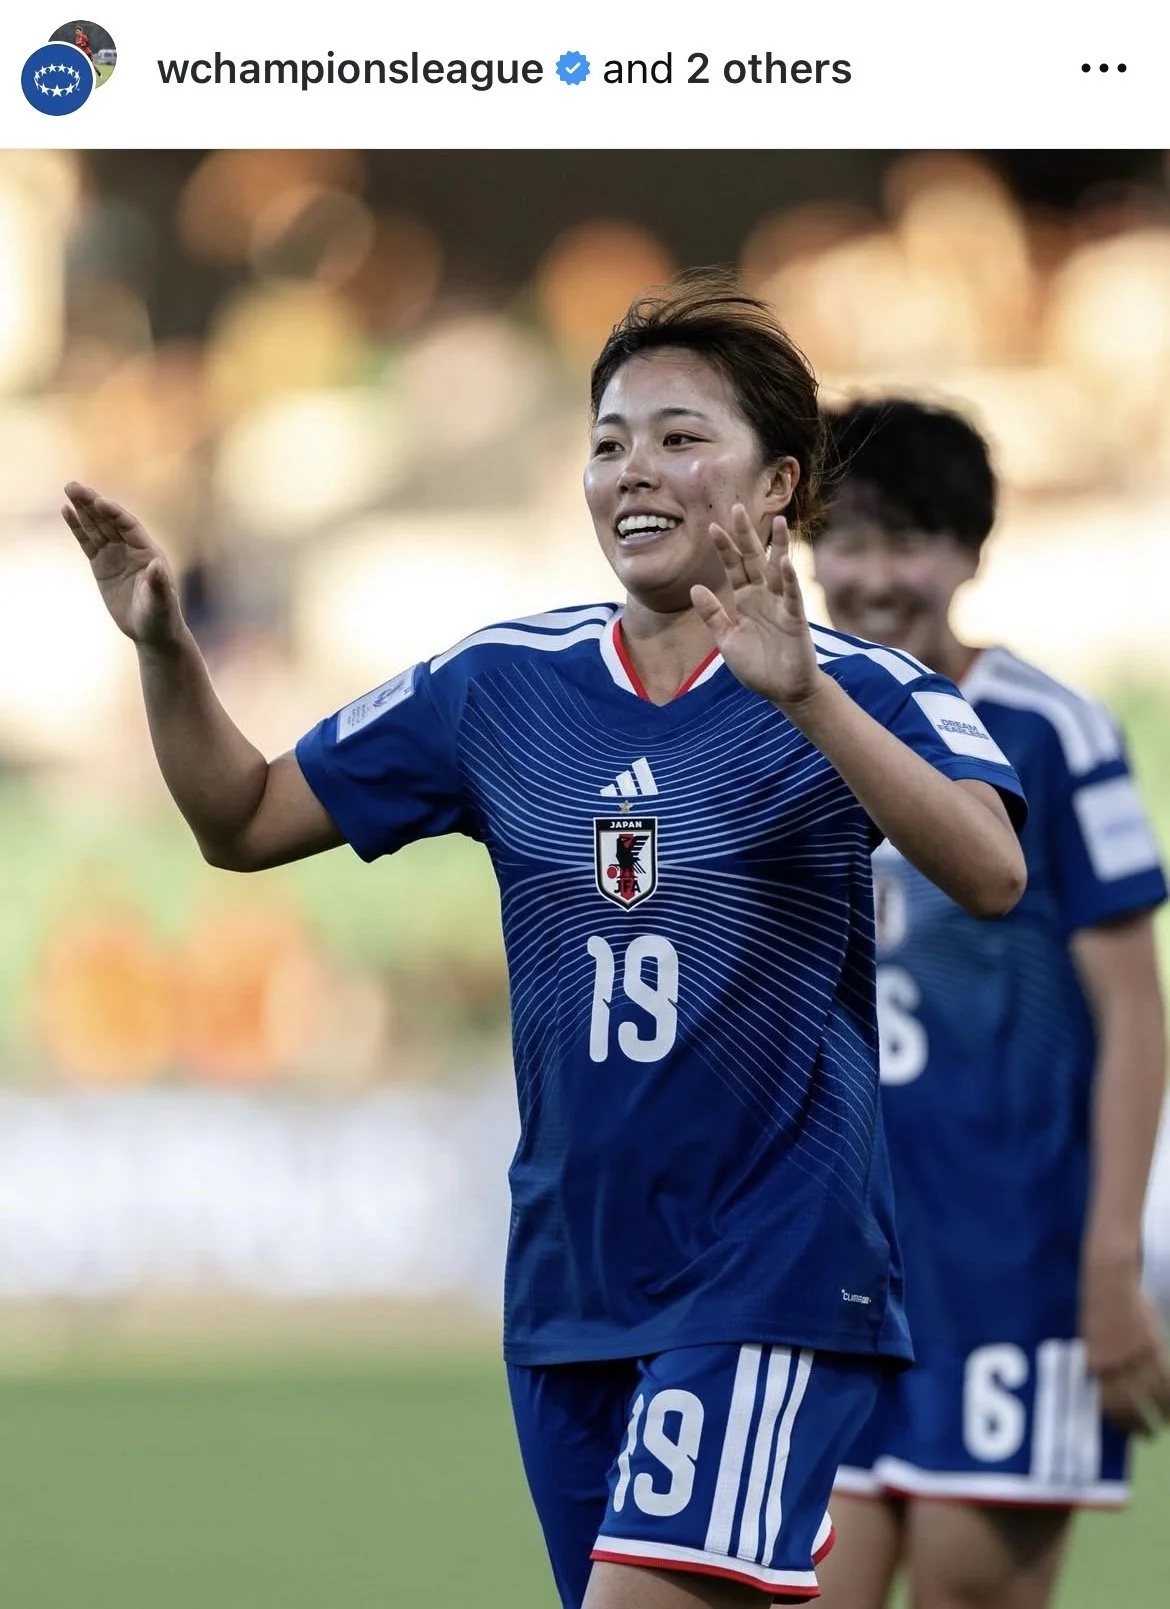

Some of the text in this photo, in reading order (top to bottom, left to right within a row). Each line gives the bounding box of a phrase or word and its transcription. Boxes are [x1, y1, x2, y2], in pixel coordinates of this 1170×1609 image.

[610, 821, 642, 829] JAPAN
[614, 880, 641, 894] JFA
[587, 935, 679, 1063] 19
[613, 1389, 705, 1517] 19
[965, 1344, 1027, 1461] 6
